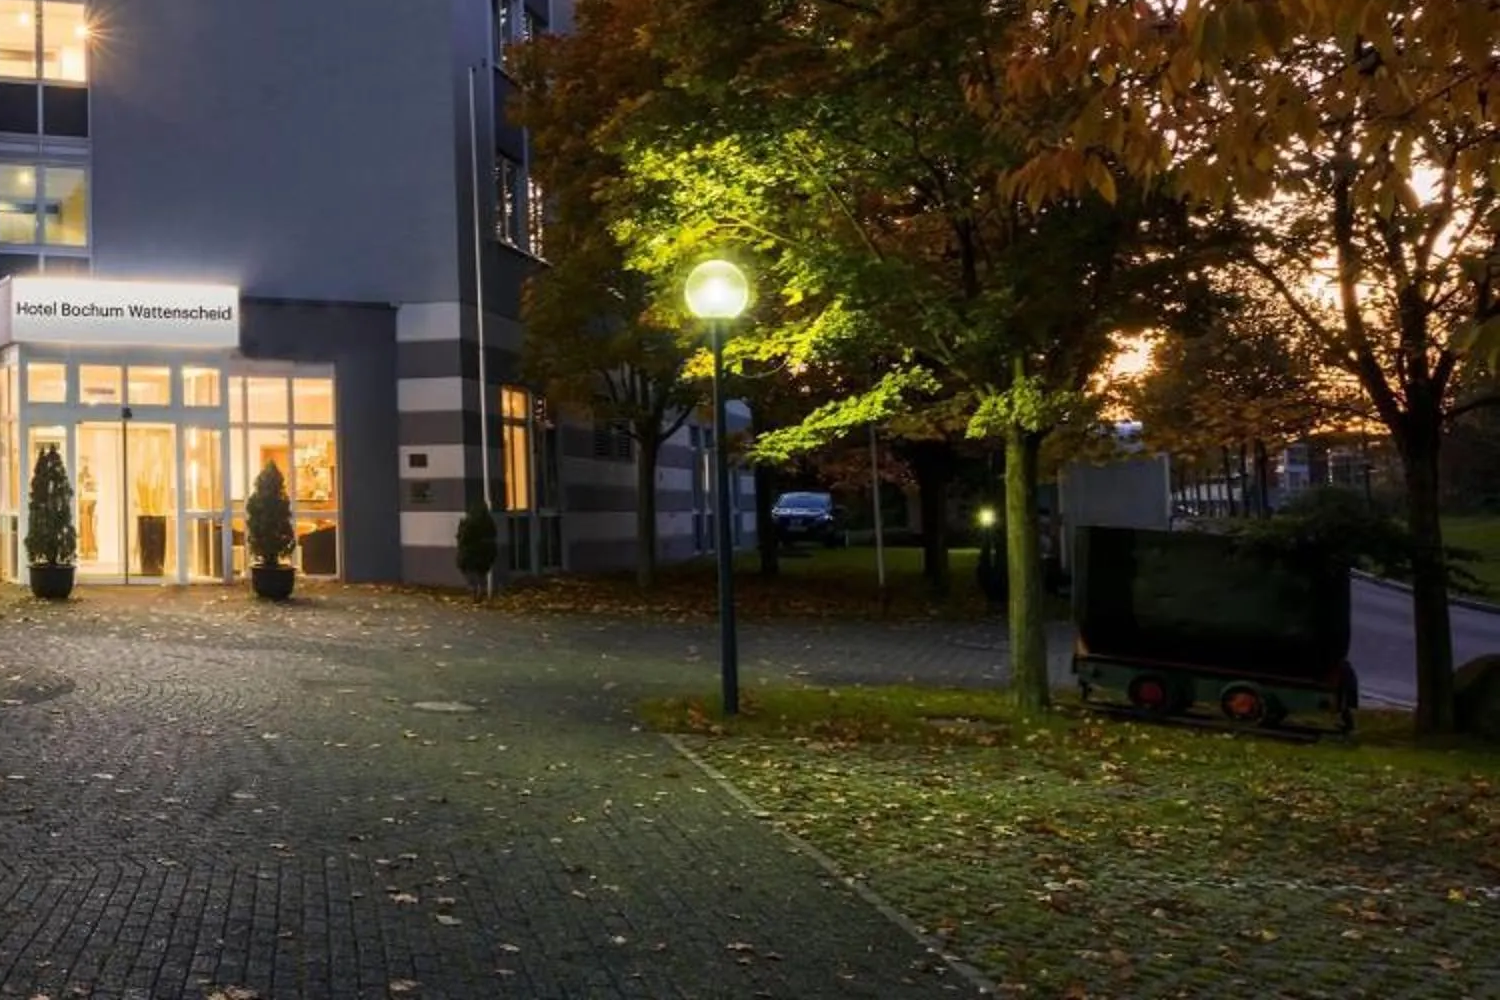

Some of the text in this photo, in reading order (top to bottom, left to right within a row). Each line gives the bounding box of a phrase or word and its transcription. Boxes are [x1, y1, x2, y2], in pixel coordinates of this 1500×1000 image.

[16, 301, 232, 321] Hotel Bochum Wattenscheid
